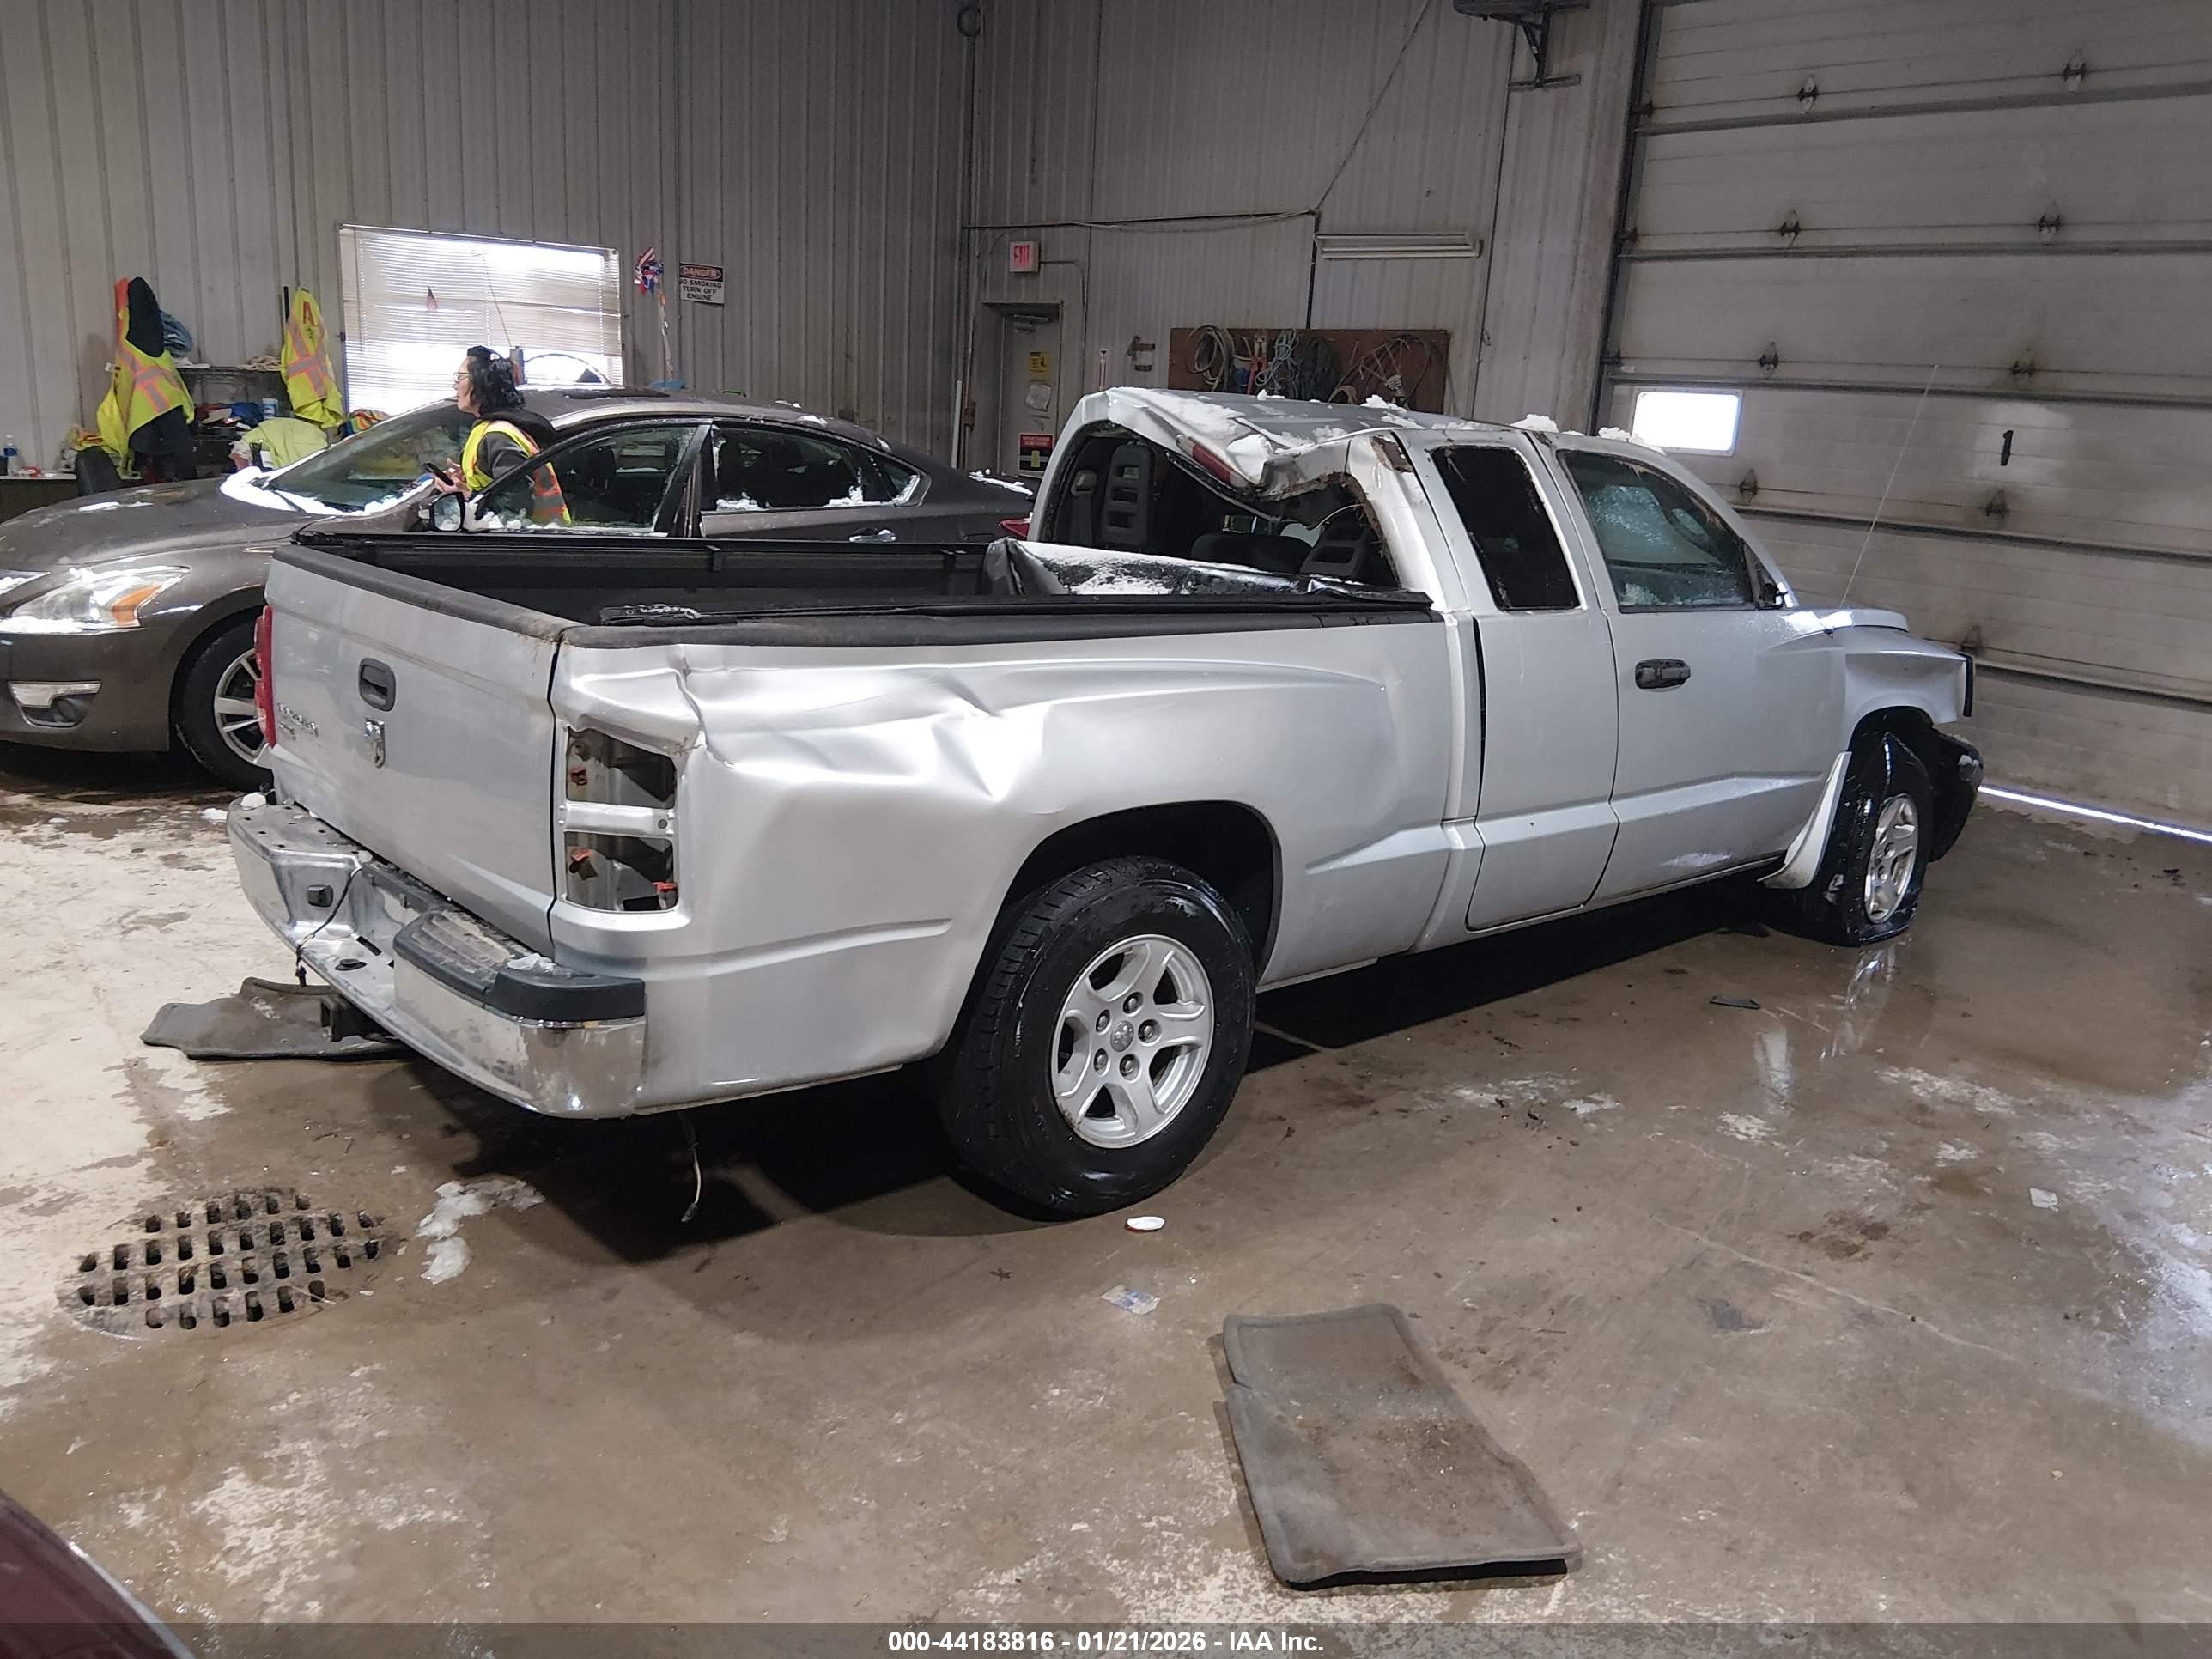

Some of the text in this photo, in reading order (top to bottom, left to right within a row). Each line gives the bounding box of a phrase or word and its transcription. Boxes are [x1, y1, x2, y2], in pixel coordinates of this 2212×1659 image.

[1013, 245, 1031, 265] EXIT
[683, 267, 718, 279] DANGER
[690, 279, 722, 289] SMOKING
[687, 293, 712, 301] ENGINE
[2000, 429, 2014, 467] 1
